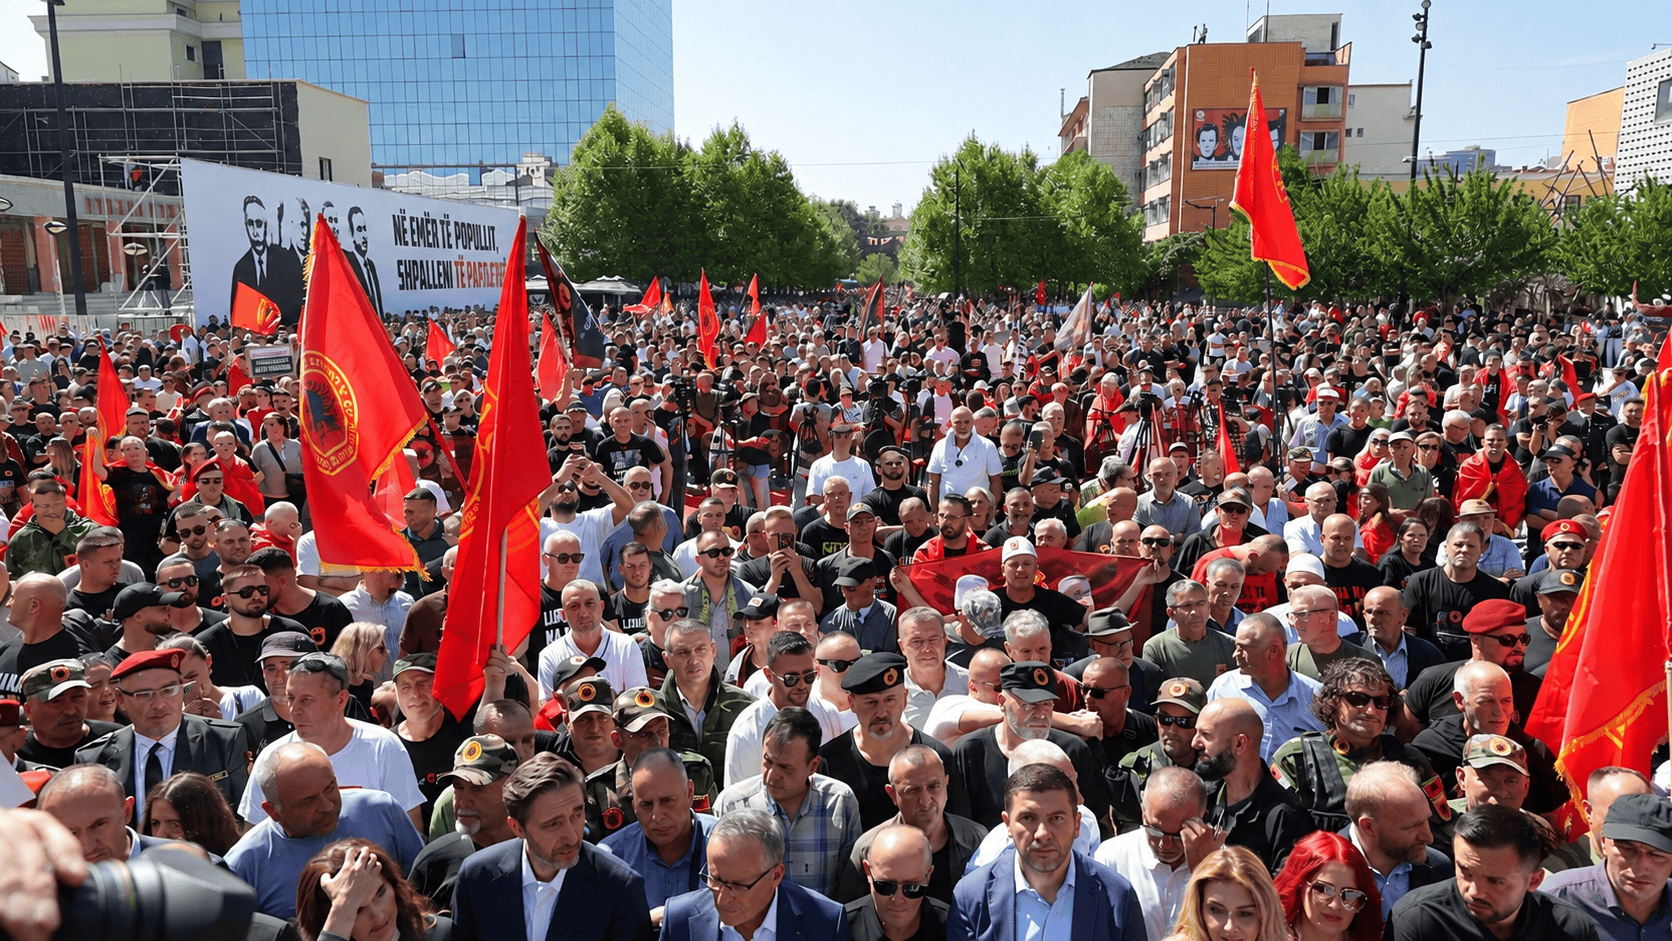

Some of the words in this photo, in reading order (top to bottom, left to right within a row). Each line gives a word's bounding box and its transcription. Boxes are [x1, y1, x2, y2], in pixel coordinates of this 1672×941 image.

[392, 208, 409, 246] NË
[409, 211, 439, 248] EMËR
[439, 213, 452, 249] TË
[454, 221, 498, 254] POPULLIT,
[397, 259, 453, 290] SHPALLENI
[454, 254, 466, 288] TË
